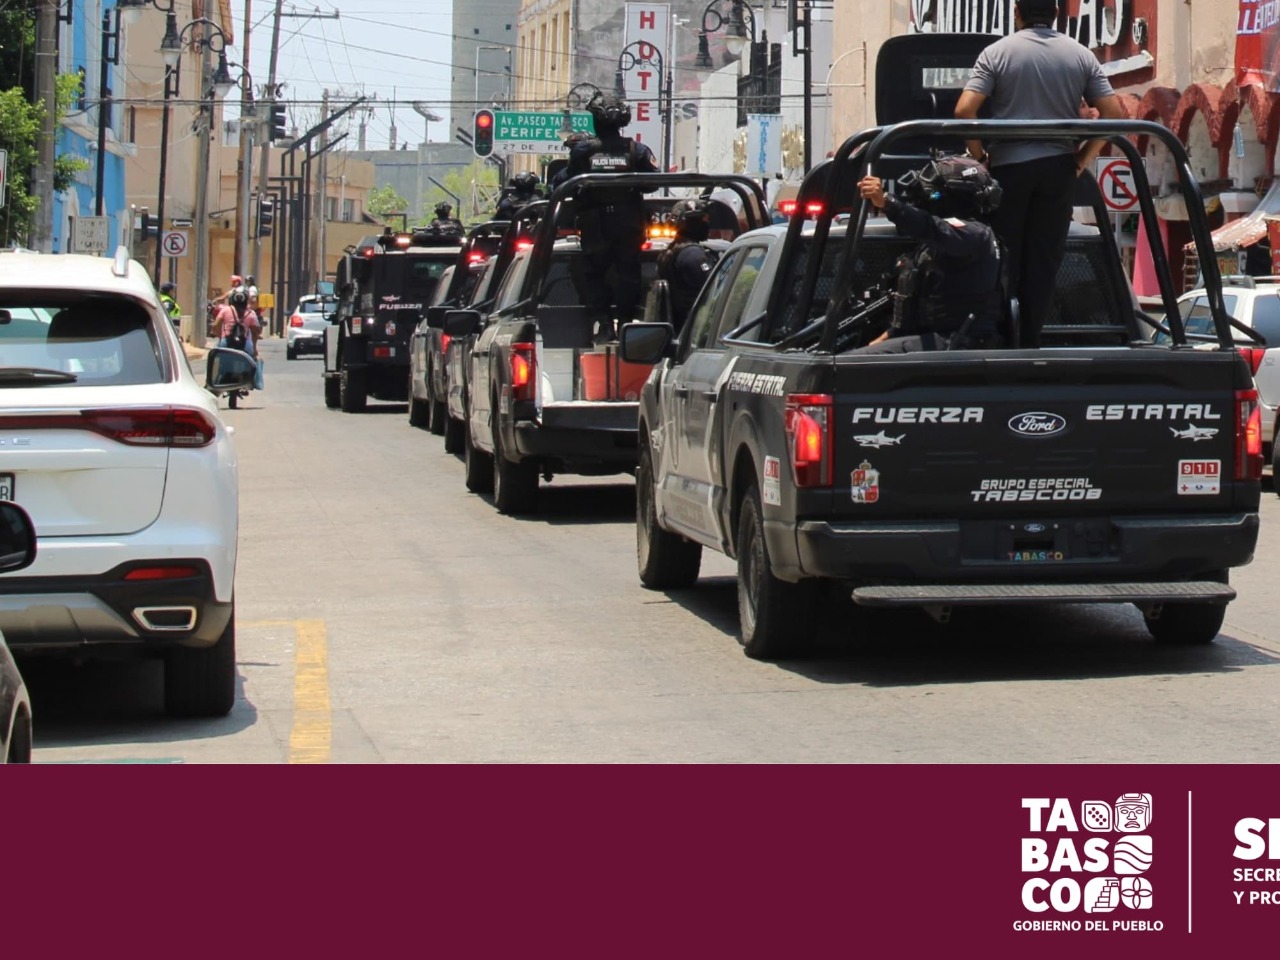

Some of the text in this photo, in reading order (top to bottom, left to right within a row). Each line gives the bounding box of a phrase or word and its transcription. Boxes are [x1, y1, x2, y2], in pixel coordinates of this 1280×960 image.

[517, 115, 547, 127] PASEO
[550, 116, 589, 127] TASCO
[750, 374, 787, 397] ESTATAL
[852, 404, 1221, 432] FUERZA Ford ESTATAL
[1183, 463, 1216, 474] 911
[980, 478, 1094, 490] GRUPO ESPECIAL
[1008, 551, 1064, 561] TABASCO
